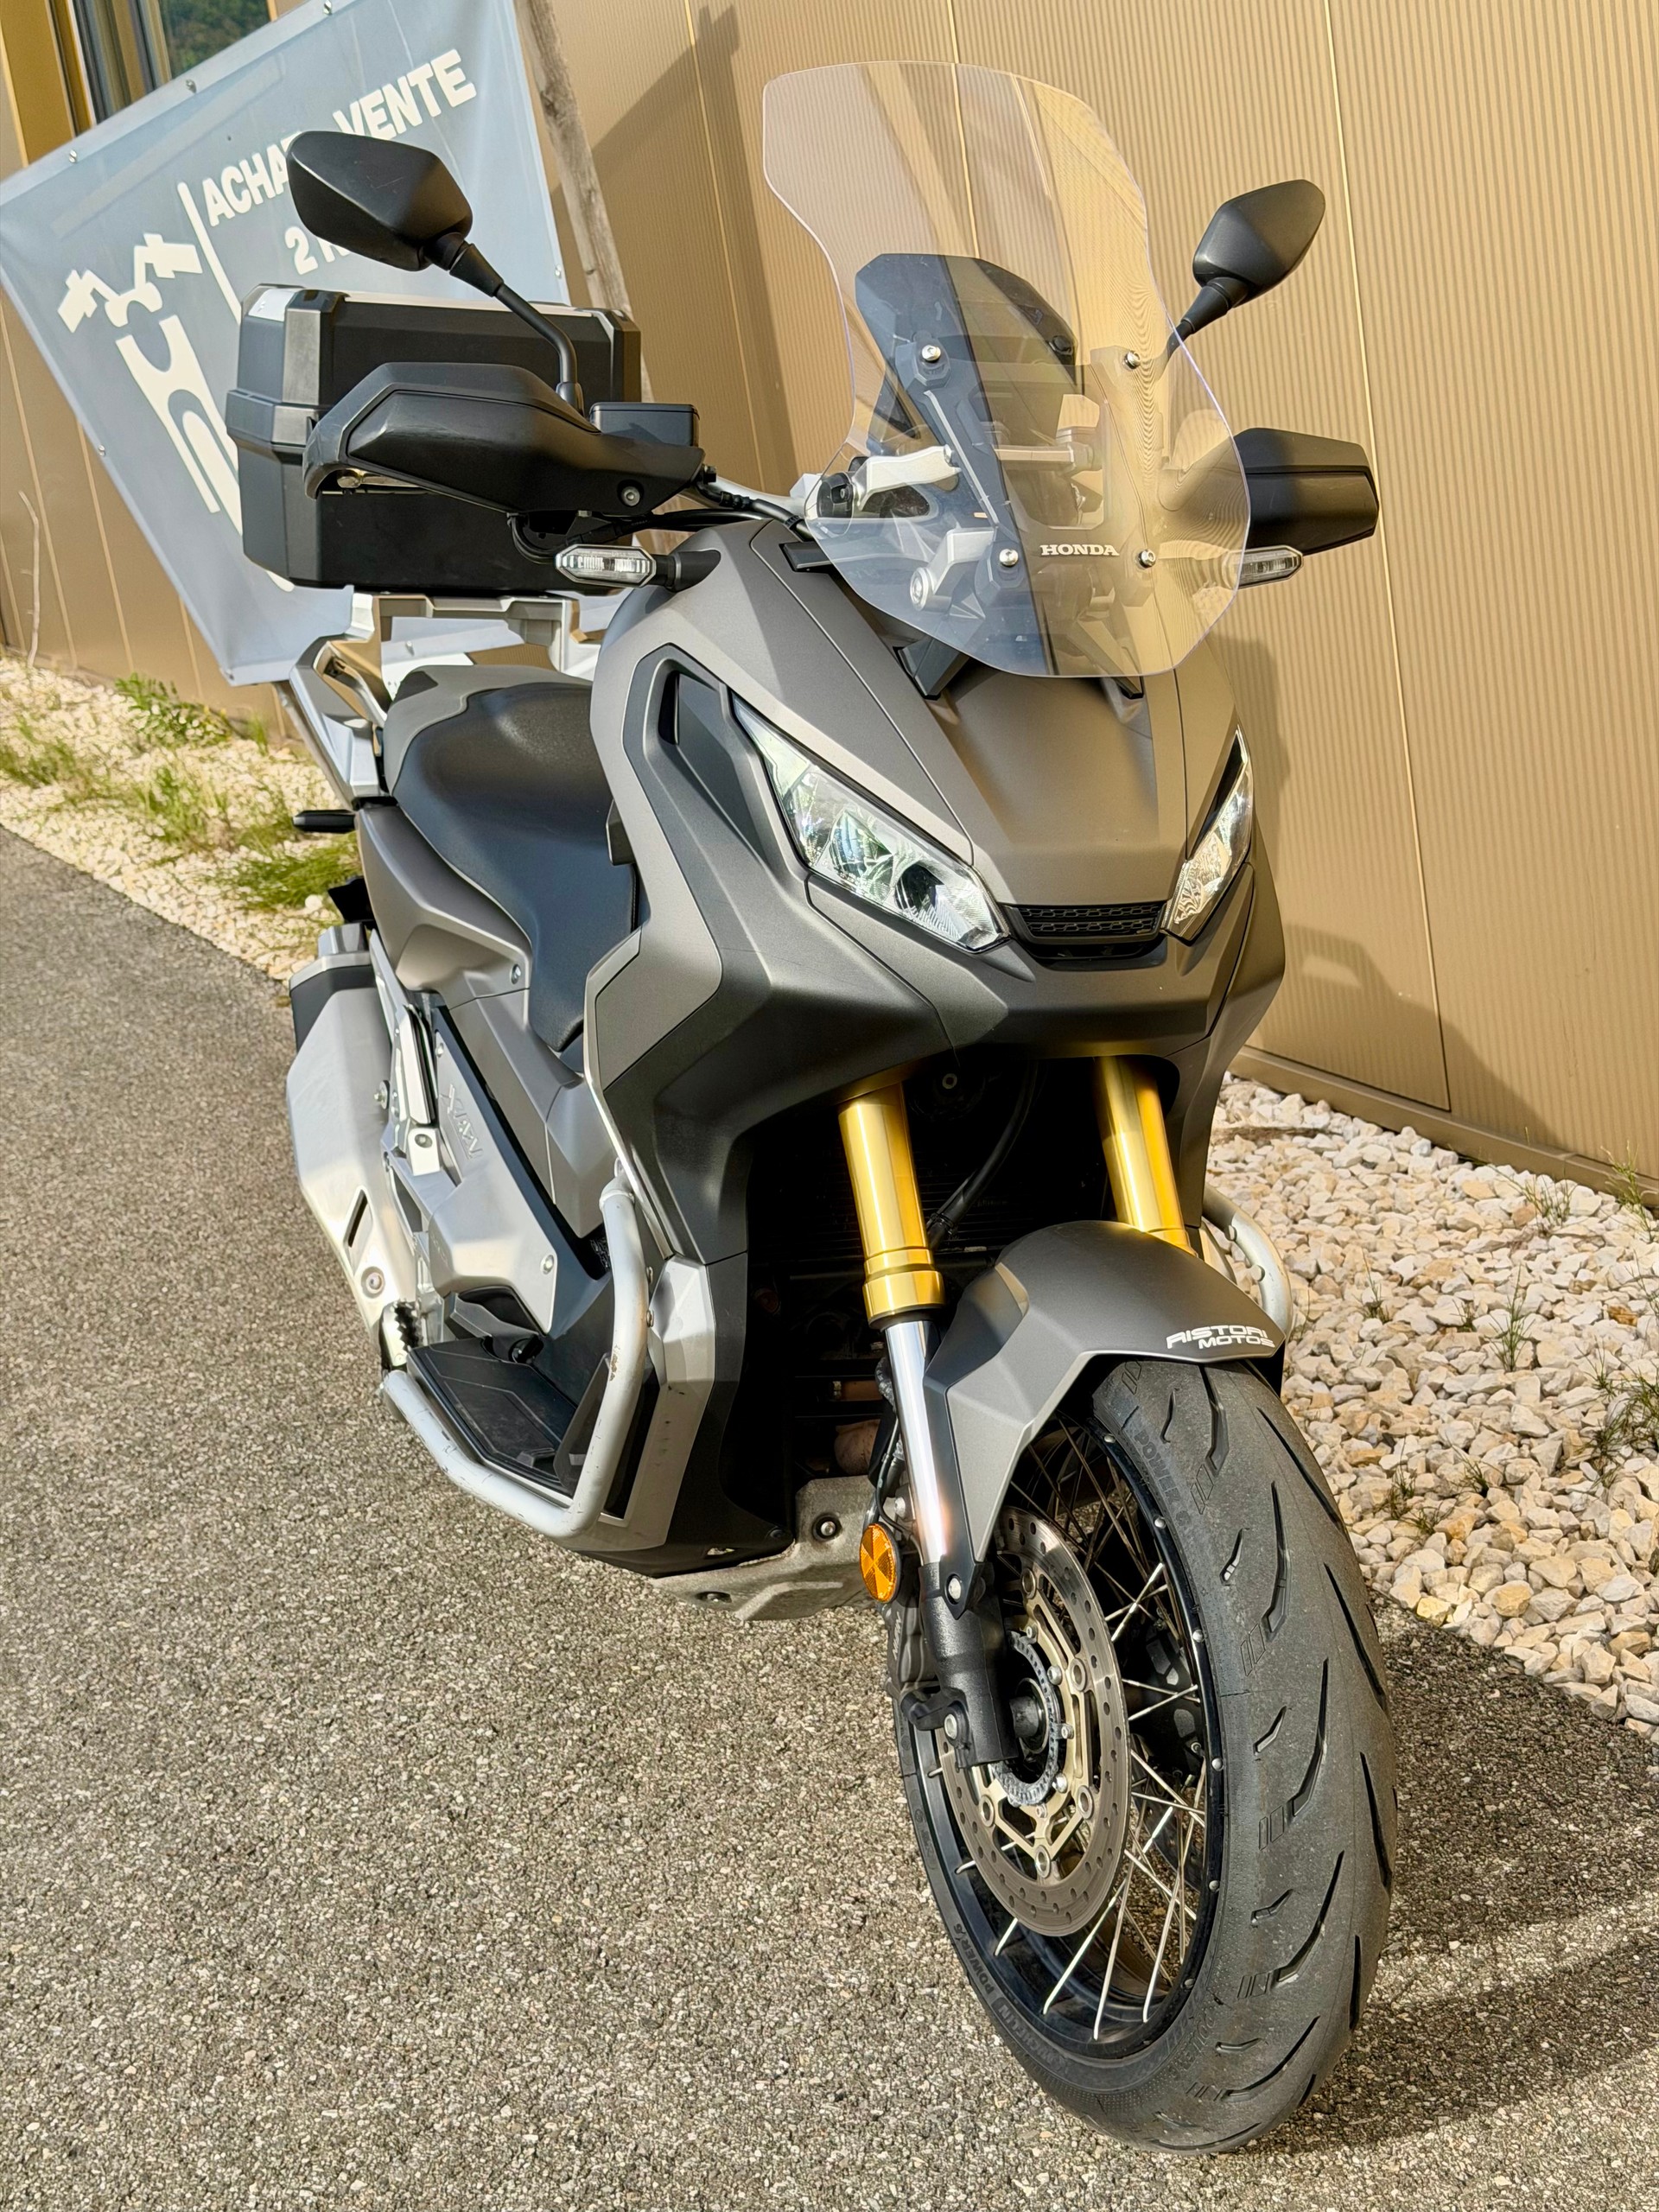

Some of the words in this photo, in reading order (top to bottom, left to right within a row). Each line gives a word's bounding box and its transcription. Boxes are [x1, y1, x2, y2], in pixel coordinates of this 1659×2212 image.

[333, 49, 476, 140] VENTE
[284, 226, 318, 275] 2
[1039, 543, 1120, 556] HONDA
[1166, 1325, 1268, 1349] RISTORI
[1198, 1335, 1275, 1349] MOTOS
